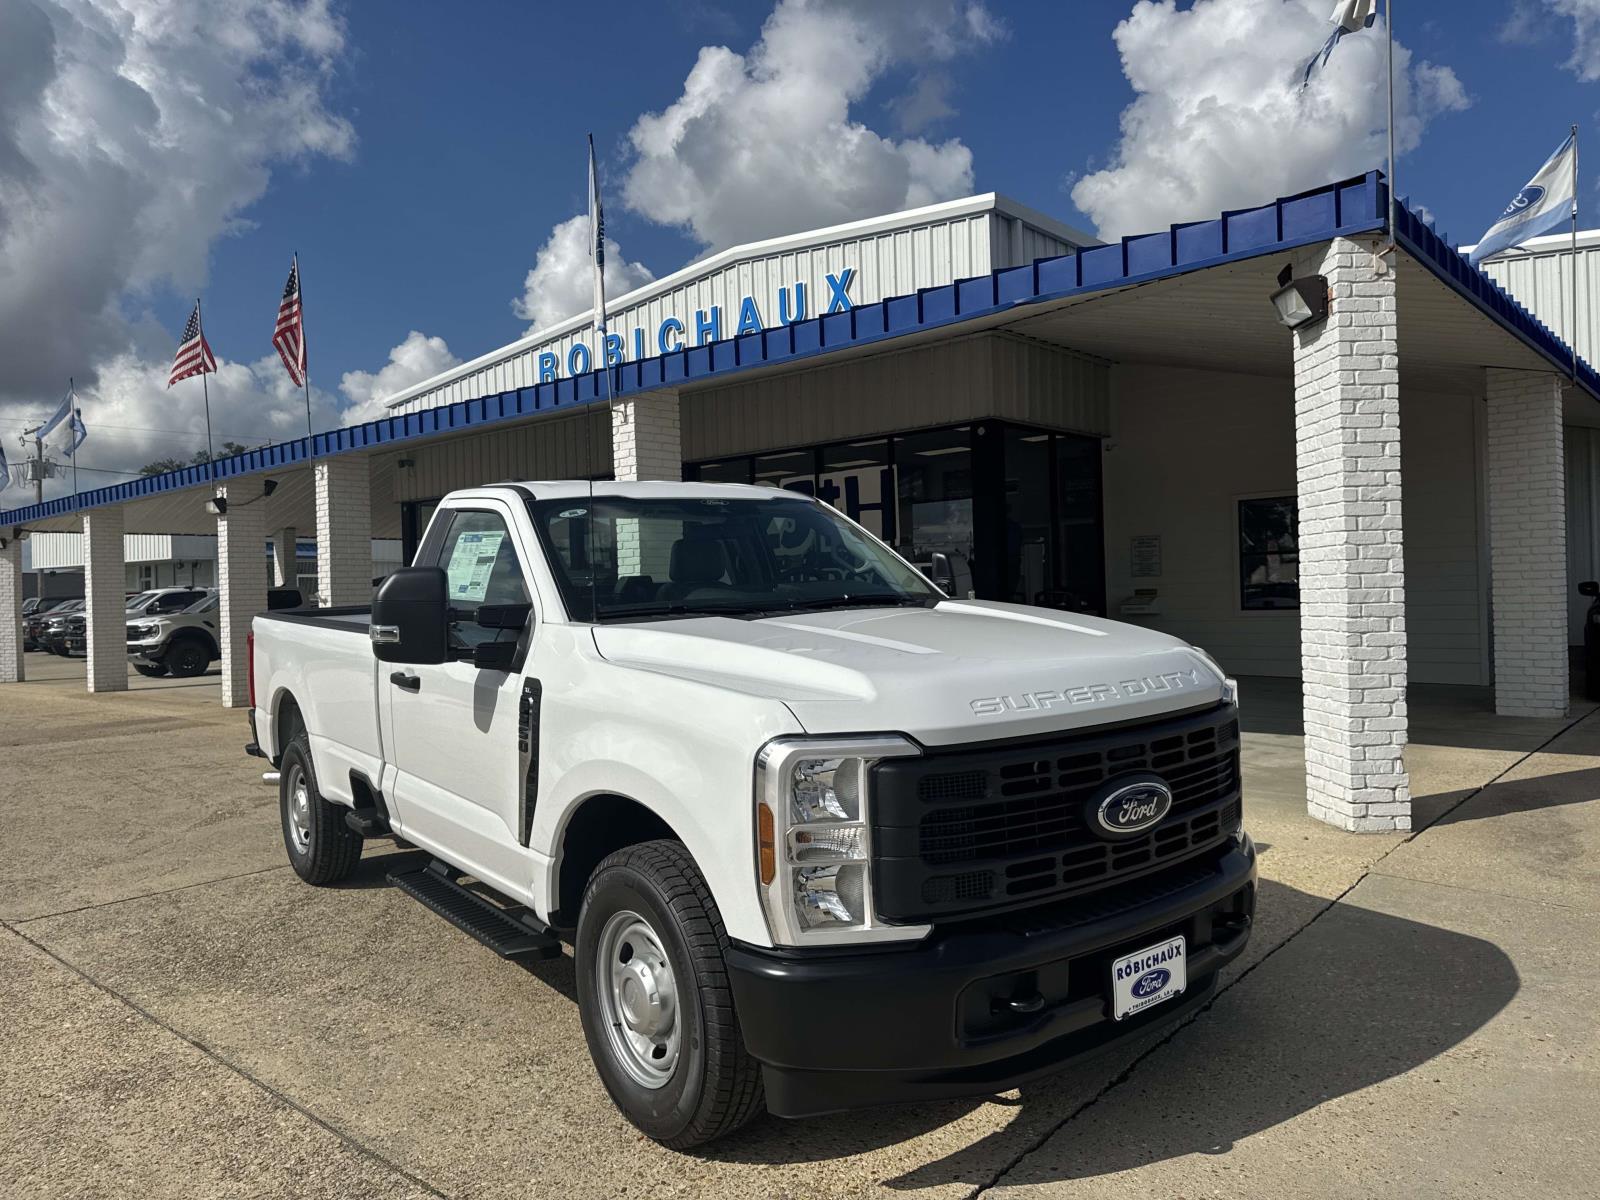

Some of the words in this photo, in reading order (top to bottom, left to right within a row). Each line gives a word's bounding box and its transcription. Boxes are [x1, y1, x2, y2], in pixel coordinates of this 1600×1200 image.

[538, 267, 856, 383] ROBICHAUX
[969, 683, 1121, 717] SUPER
[1120, 669, 1199, 697] DUTY
[1118, 792, 1158, 824] Ford
[1116, 944, 1182, 981] ROBICHAUX
[1139, 973, 1164, 995] Ford
